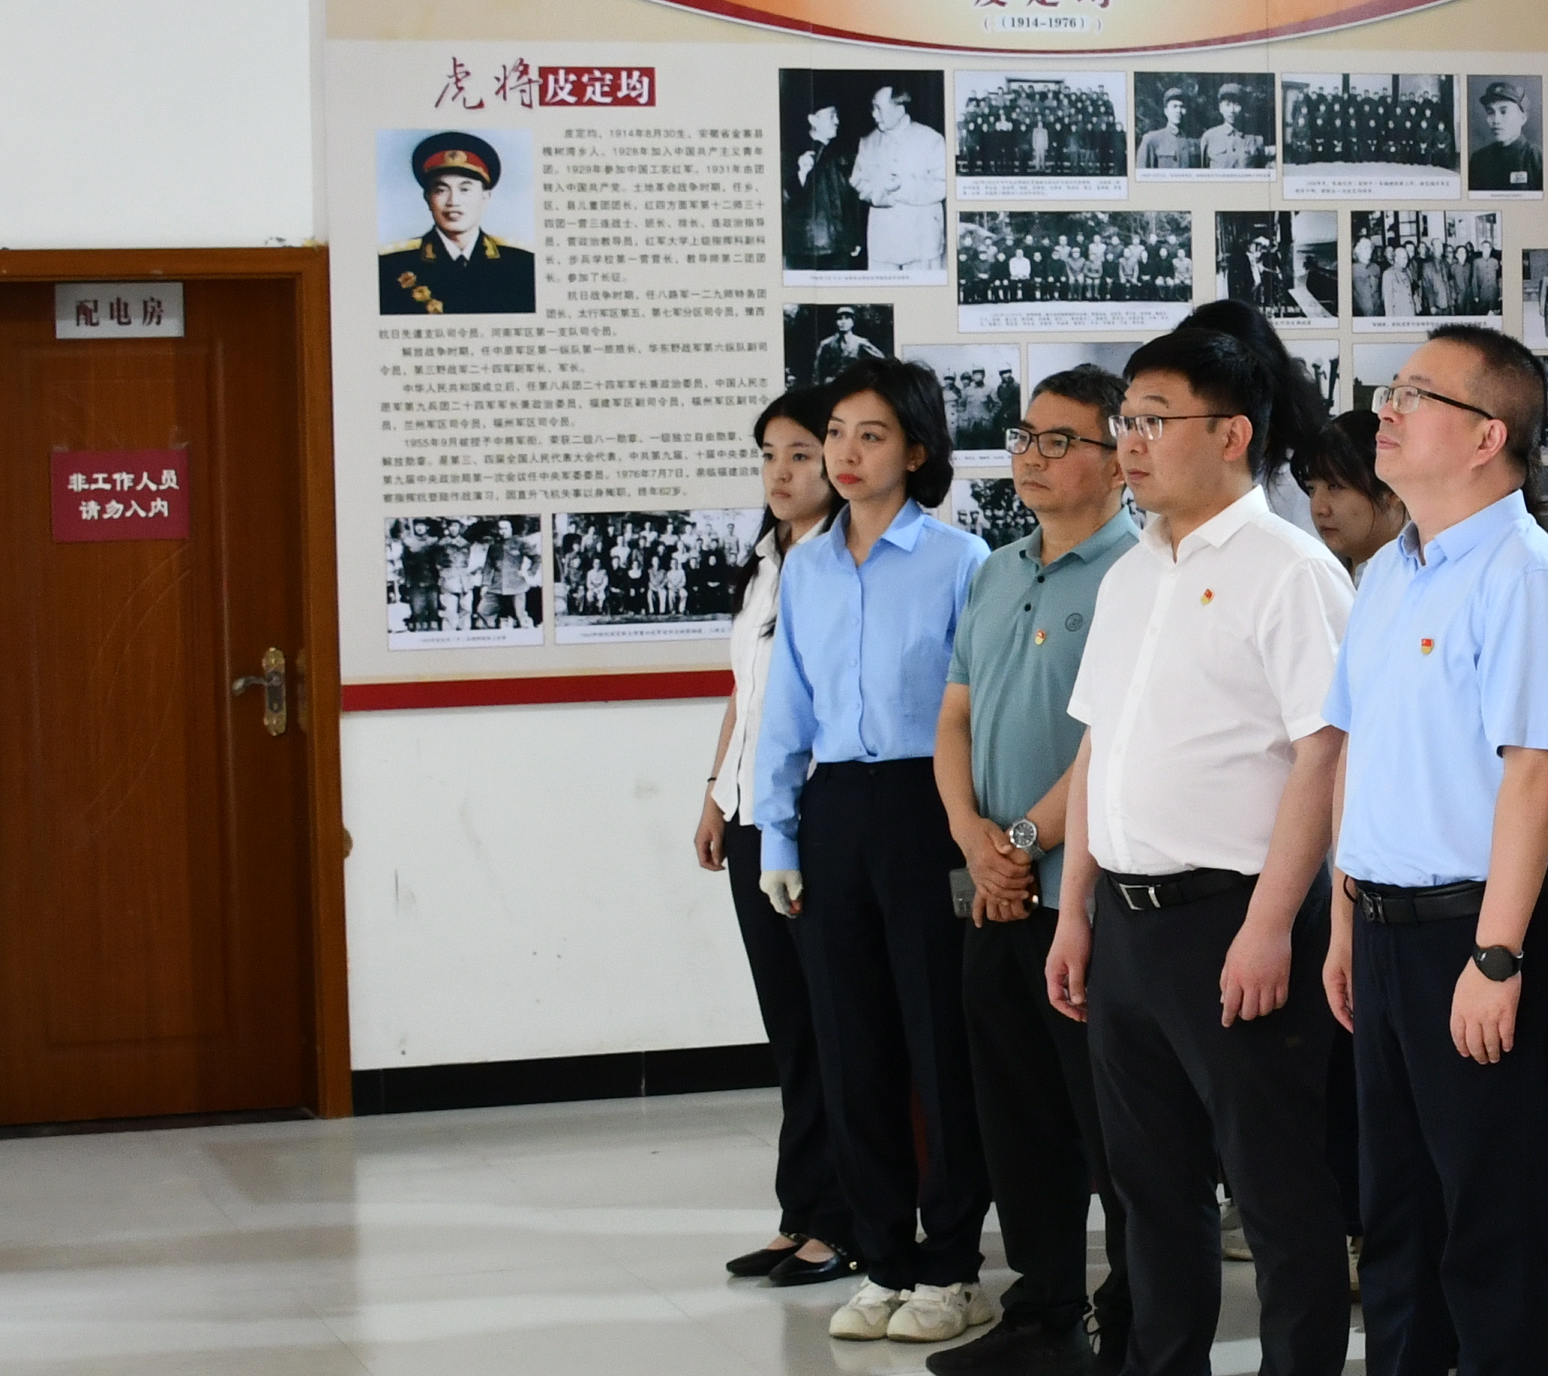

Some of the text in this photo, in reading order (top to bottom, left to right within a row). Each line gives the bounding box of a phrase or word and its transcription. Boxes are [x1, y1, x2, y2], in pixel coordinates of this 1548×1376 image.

[434, 57, 651, 110] 虎将 皮定均
[76, 296, 164, 327] 配电房
[68, 469, 179, 492] 非工作人员
[79, 497, 169, 520] 请勿入内
